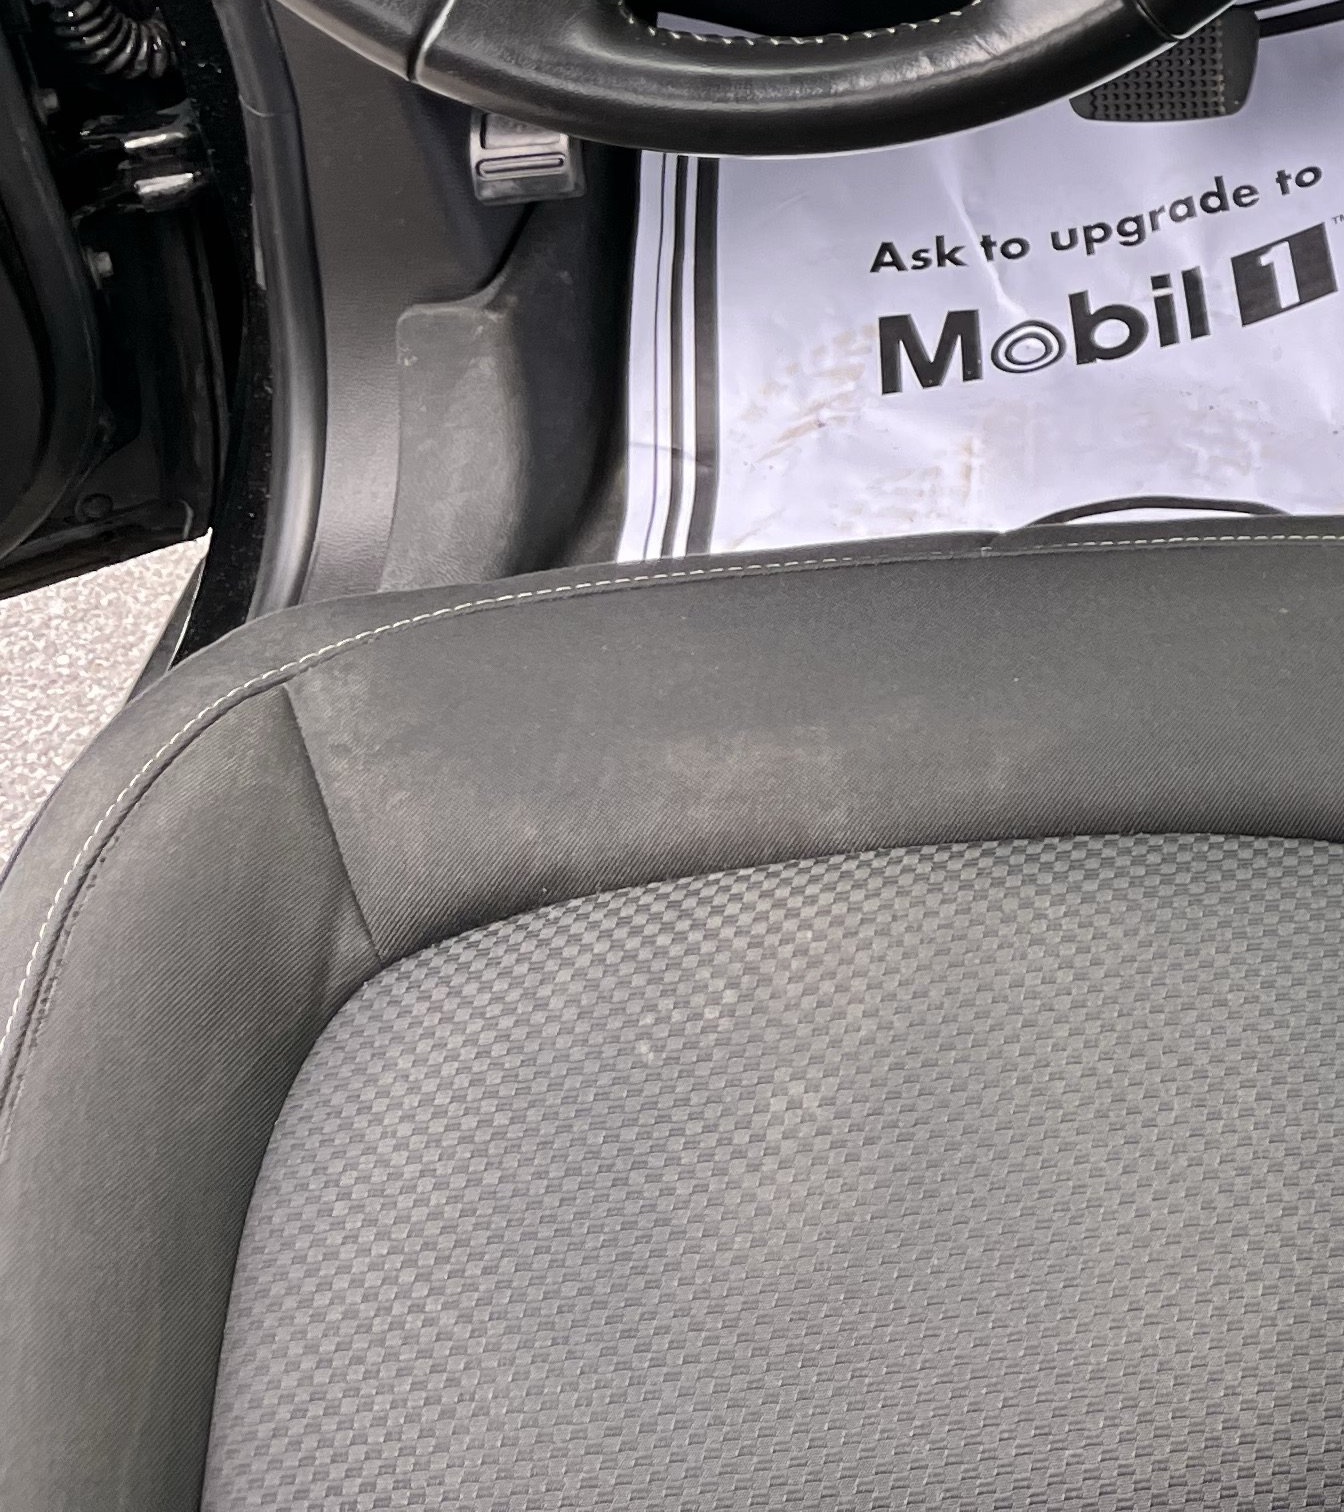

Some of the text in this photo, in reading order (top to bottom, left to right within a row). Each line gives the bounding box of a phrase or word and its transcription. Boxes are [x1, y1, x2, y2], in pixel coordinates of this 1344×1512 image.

[868, 163, 1323, 275] Ask to upgrade to
[878, 268, 1210, 396] Mobil
